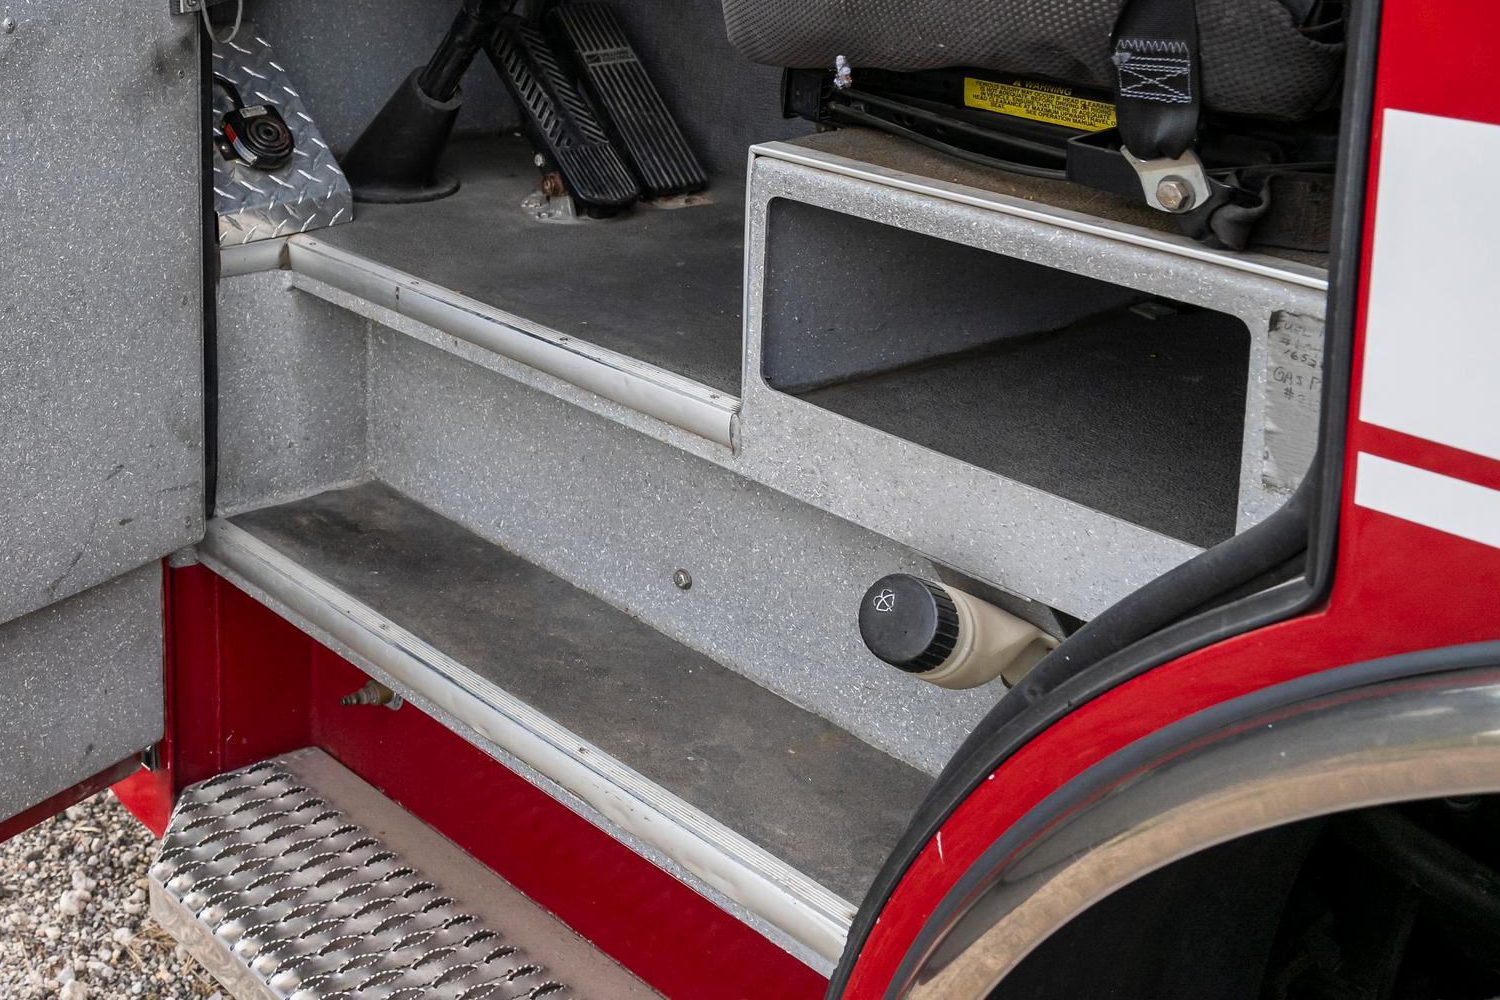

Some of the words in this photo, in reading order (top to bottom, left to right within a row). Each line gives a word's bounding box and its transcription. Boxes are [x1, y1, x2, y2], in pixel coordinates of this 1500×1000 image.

[1025, 80, 1072, 96] WARNING
[988, 96, 1021, 107] CLEARANCE
[1038, 111, 1071, 122] OPERATION
[1273, 366, 1304, 387] GAS
